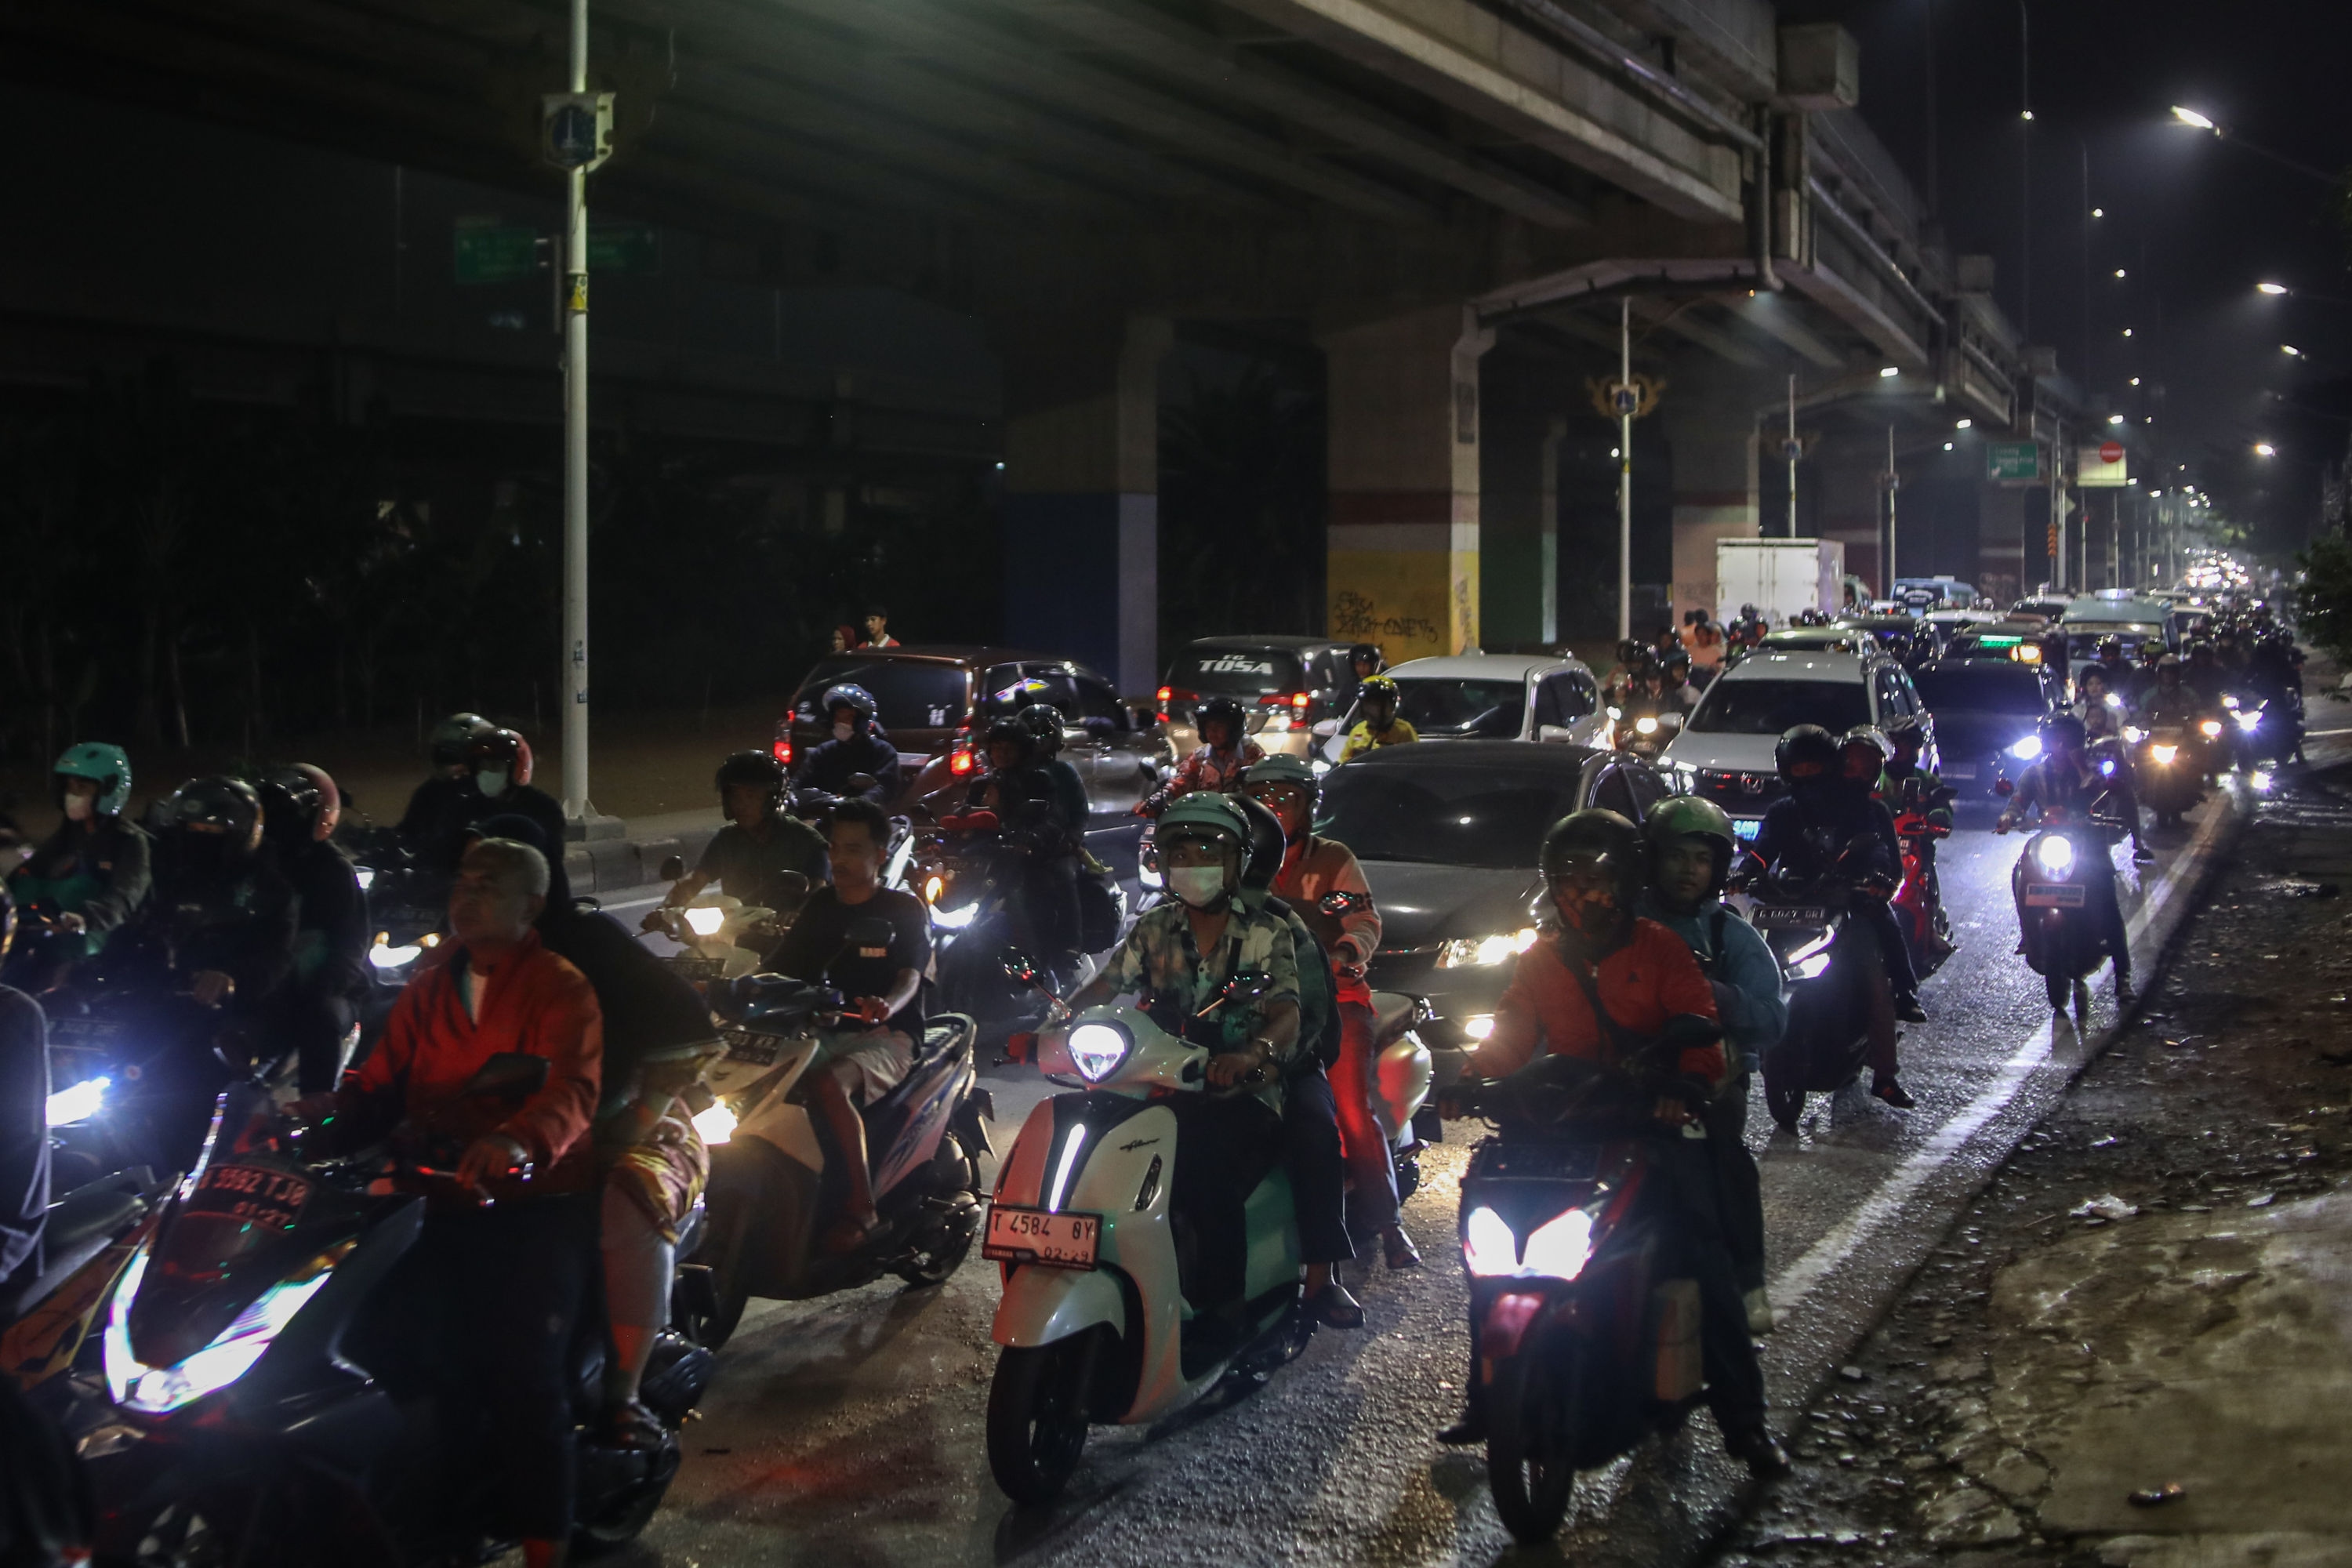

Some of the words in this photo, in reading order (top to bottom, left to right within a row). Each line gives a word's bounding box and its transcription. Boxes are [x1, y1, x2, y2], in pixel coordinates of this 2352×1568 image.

[1199, 660, 1272, 673] TOSA
[994, 1213, 1003, 1232] T
[1009, 1215, 1051, 1236] 4584
